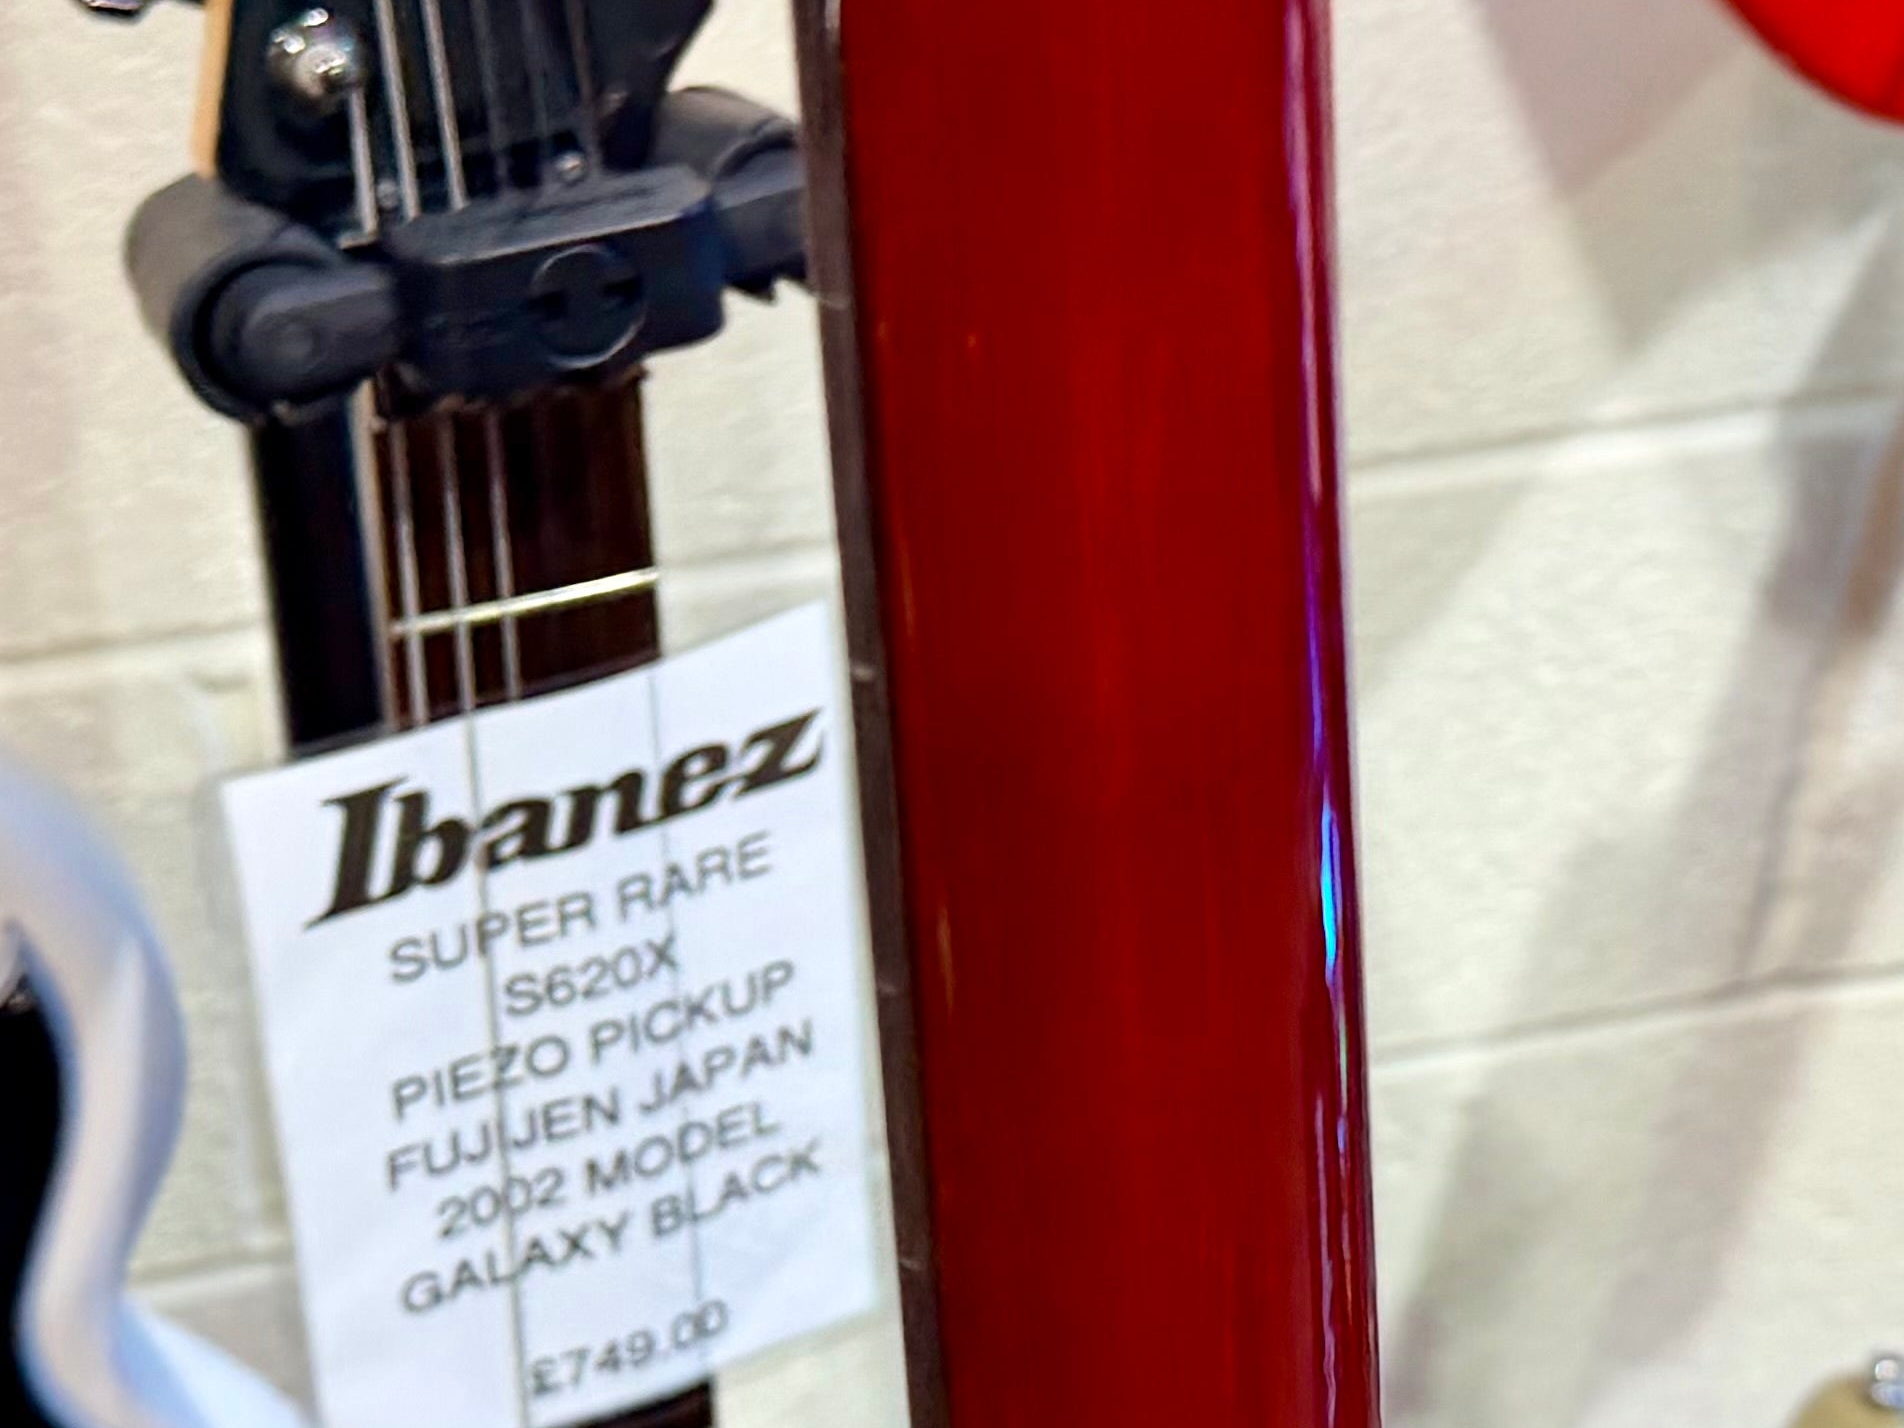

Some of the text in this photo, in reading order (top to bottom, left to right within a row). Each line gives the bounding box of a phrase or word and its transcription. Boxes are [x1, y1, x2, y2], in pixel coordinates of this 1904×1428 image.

[304, 707, 825, 930] Ibanez
[388, 830, 772, 984] SUPER RARE
[505, 934, 679, 1018] S620X
[392, 958, 795, 1118] PIEZO PICKUP
[639, 1018, 814, 1115] JAPAN
[401, 1136, 822, 1313] GALAXY BLACK
[437, 1101, 780, 1239] 2002 MODEL
[530, 1299, 730, 1396] £749.00
